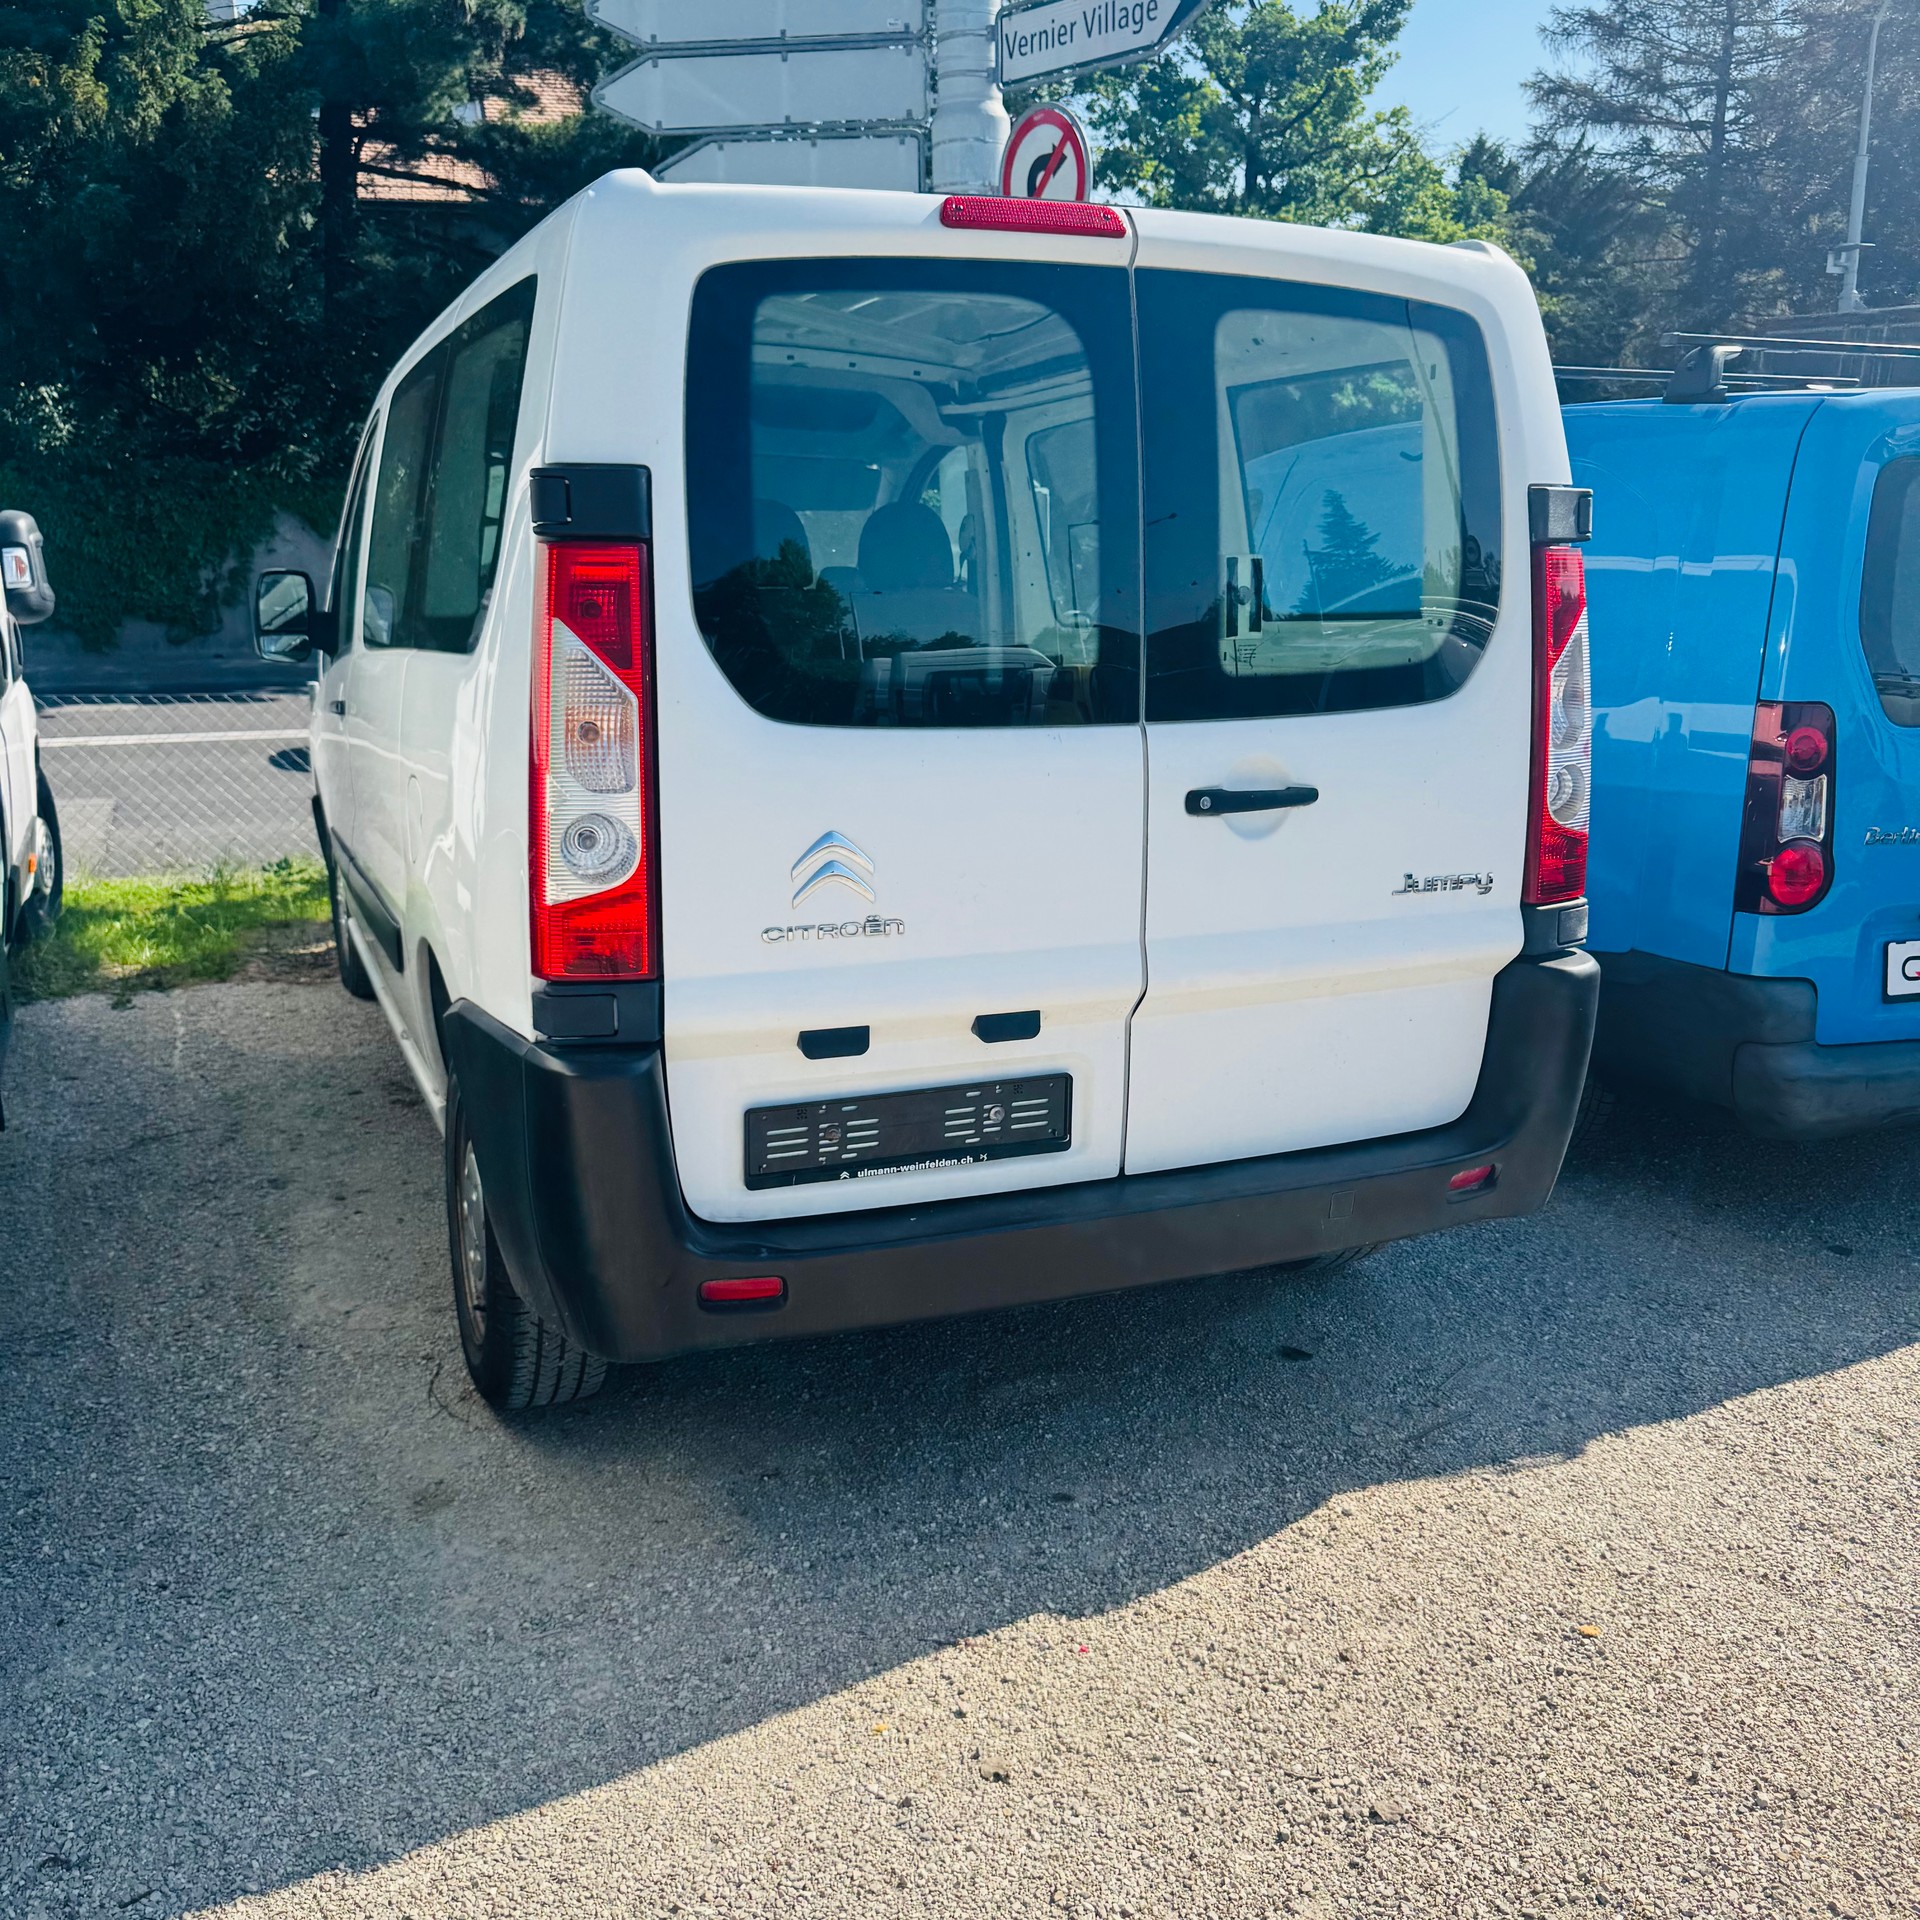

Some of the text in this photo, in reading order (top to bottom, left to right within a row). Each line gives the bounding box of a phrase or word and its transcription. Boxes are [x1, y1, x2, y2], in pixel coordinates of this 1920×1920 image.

[1005, 0, 1158, 59] Vernier Village
[1392, 872, 1493, 895] Jumpy
[761, 914, 905, 944] CITROËN
[857, 1155, 973, 1178] ulmann-weinfelden.ch
